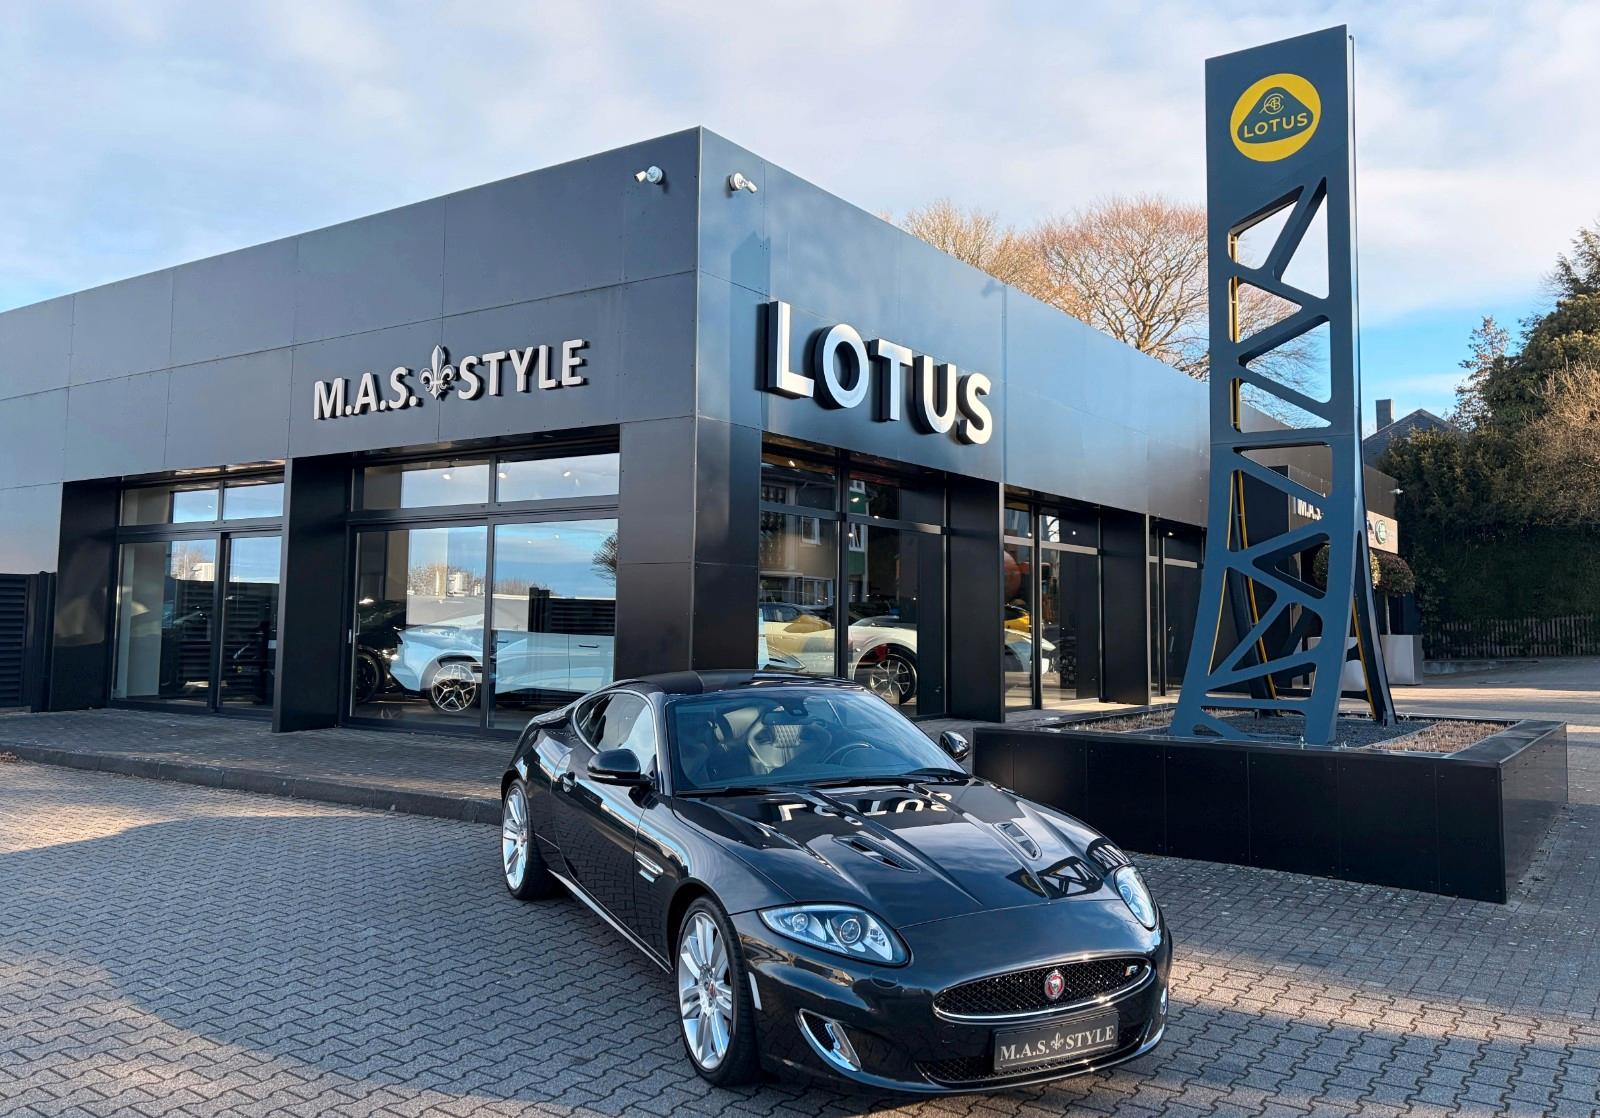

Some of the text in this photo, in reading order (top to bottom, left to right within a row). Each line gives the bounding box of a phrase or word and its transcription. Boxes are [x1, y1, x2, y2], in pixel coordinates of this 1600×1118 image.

[1244, 113, 1308, 138] LOTUS
[313, 339, 585, 420] M.A.S. STYLE
[768, 300, 993, 445] LOTUS
[1000, 1025, 1115, 1060] M.A.S. STYLE
